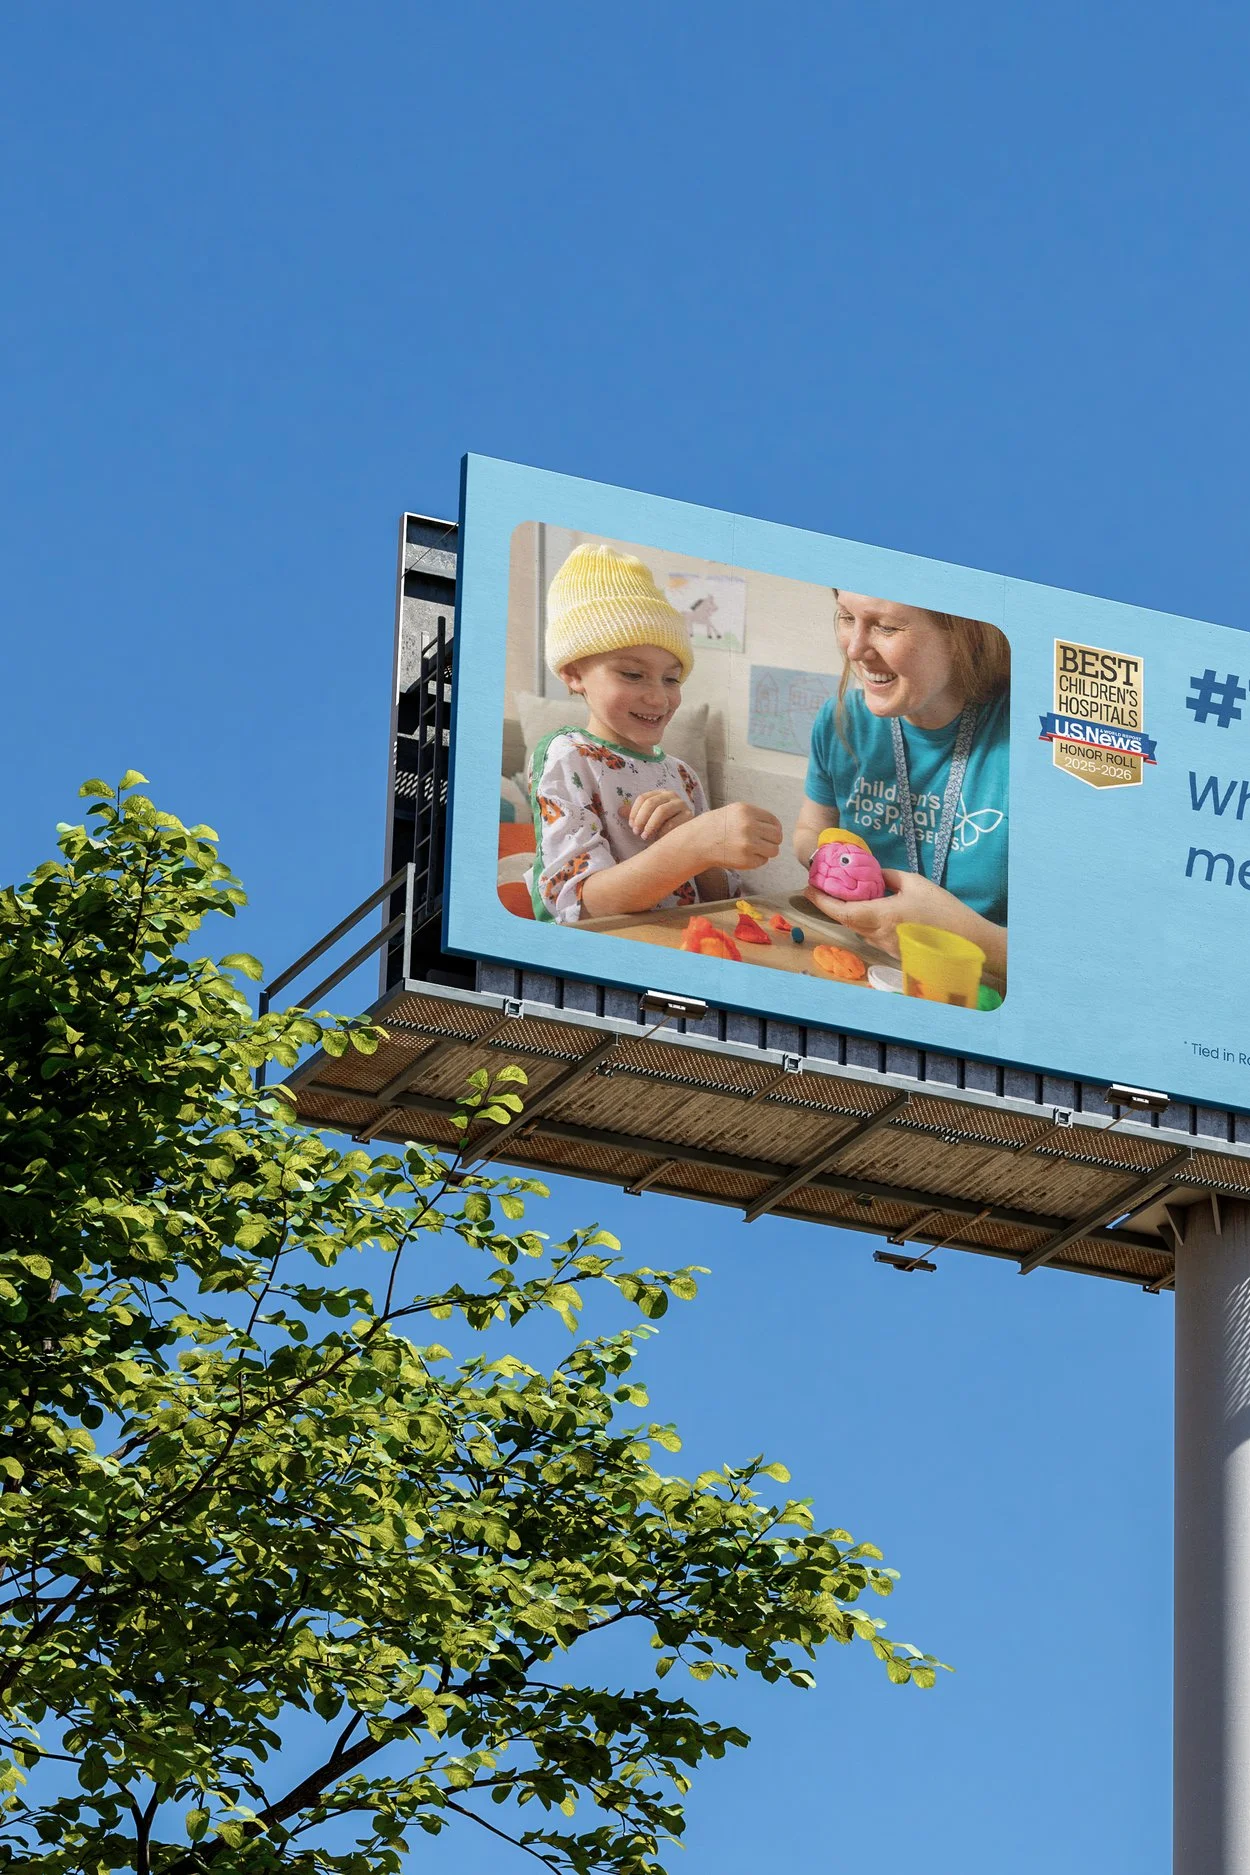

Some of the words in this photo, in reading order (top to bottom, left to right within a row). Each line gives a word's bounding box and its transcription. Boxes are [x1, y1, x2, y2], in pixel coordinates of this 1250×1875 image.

[1059, 645, 1138, 687] BEST
[1059, 674, 1138, 708] CHILDREN'S
[1058, 694, 1138, 729] HOSPITALS
[1060, 743, 1103, 762] HONOR
[1106, 752, 1137, 769] ROLL
[1064, 757, 1132, 781] 2025-2026
[854, 776, 941, 810] Childen's
[846, 793, 936, 828] Hospal
[854, 812, 882, 830] LOS
[1191, 1042, 1219, 1059] Tied
[1223, 1048, 1235, 1062] in
